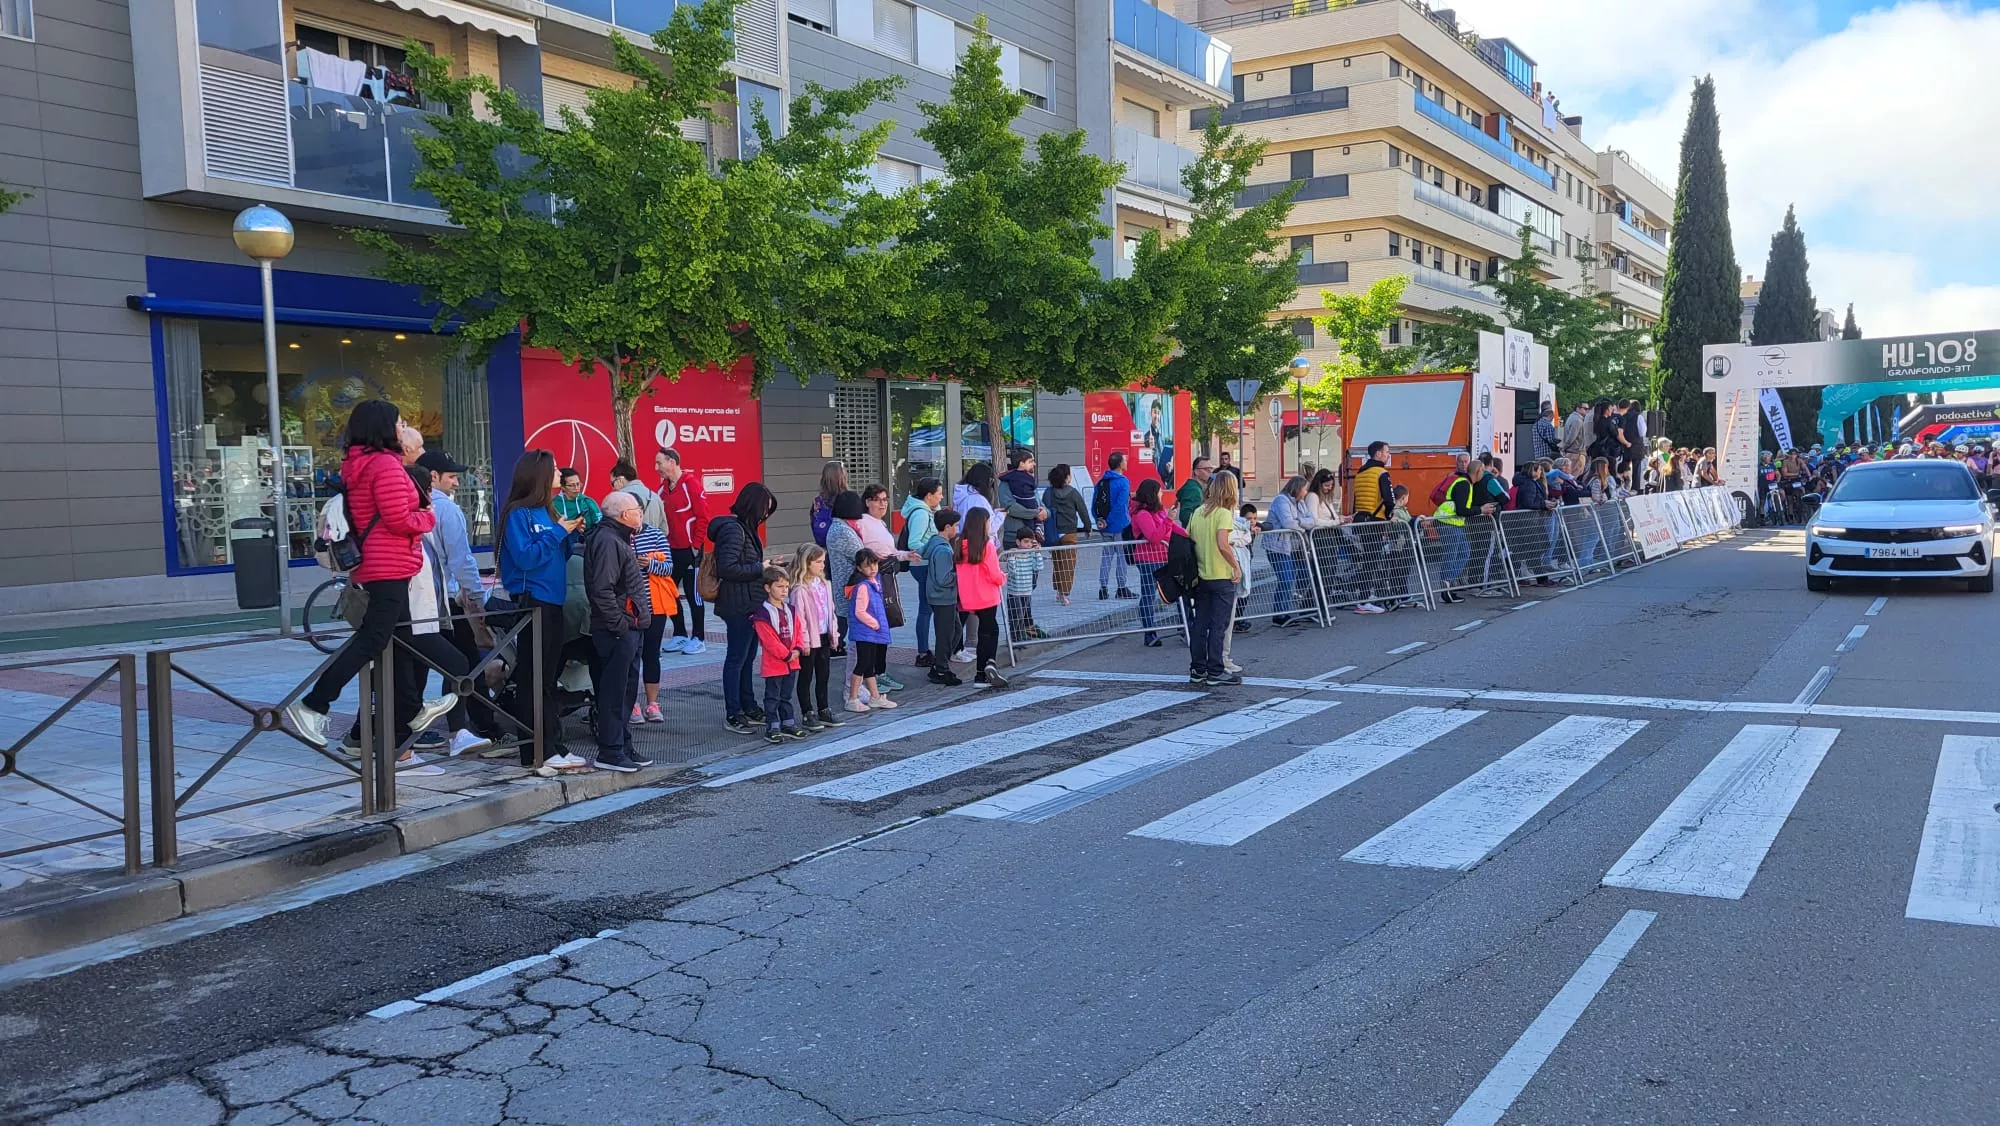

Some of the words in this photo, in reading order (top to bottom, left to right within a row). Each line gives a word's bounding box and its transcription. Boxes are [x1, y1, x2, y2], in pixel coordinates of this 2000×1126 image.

[1882, 338, 1977, 369] HU-108
[1757, 368, 1793, 376] OPEL
[654, 405, 687, 414] Estamos
[688, 407, 704, 416] muy
[725, 407, 734, 415] de
[1935, 409, 1992, 423] podoactiva
[1097, 414, 1113, 422] SATE
[679, 424, 736, 443] SATE
[1872, 548, 1897, 557] 7964
[1900, 548, 1920, 557] MLH
